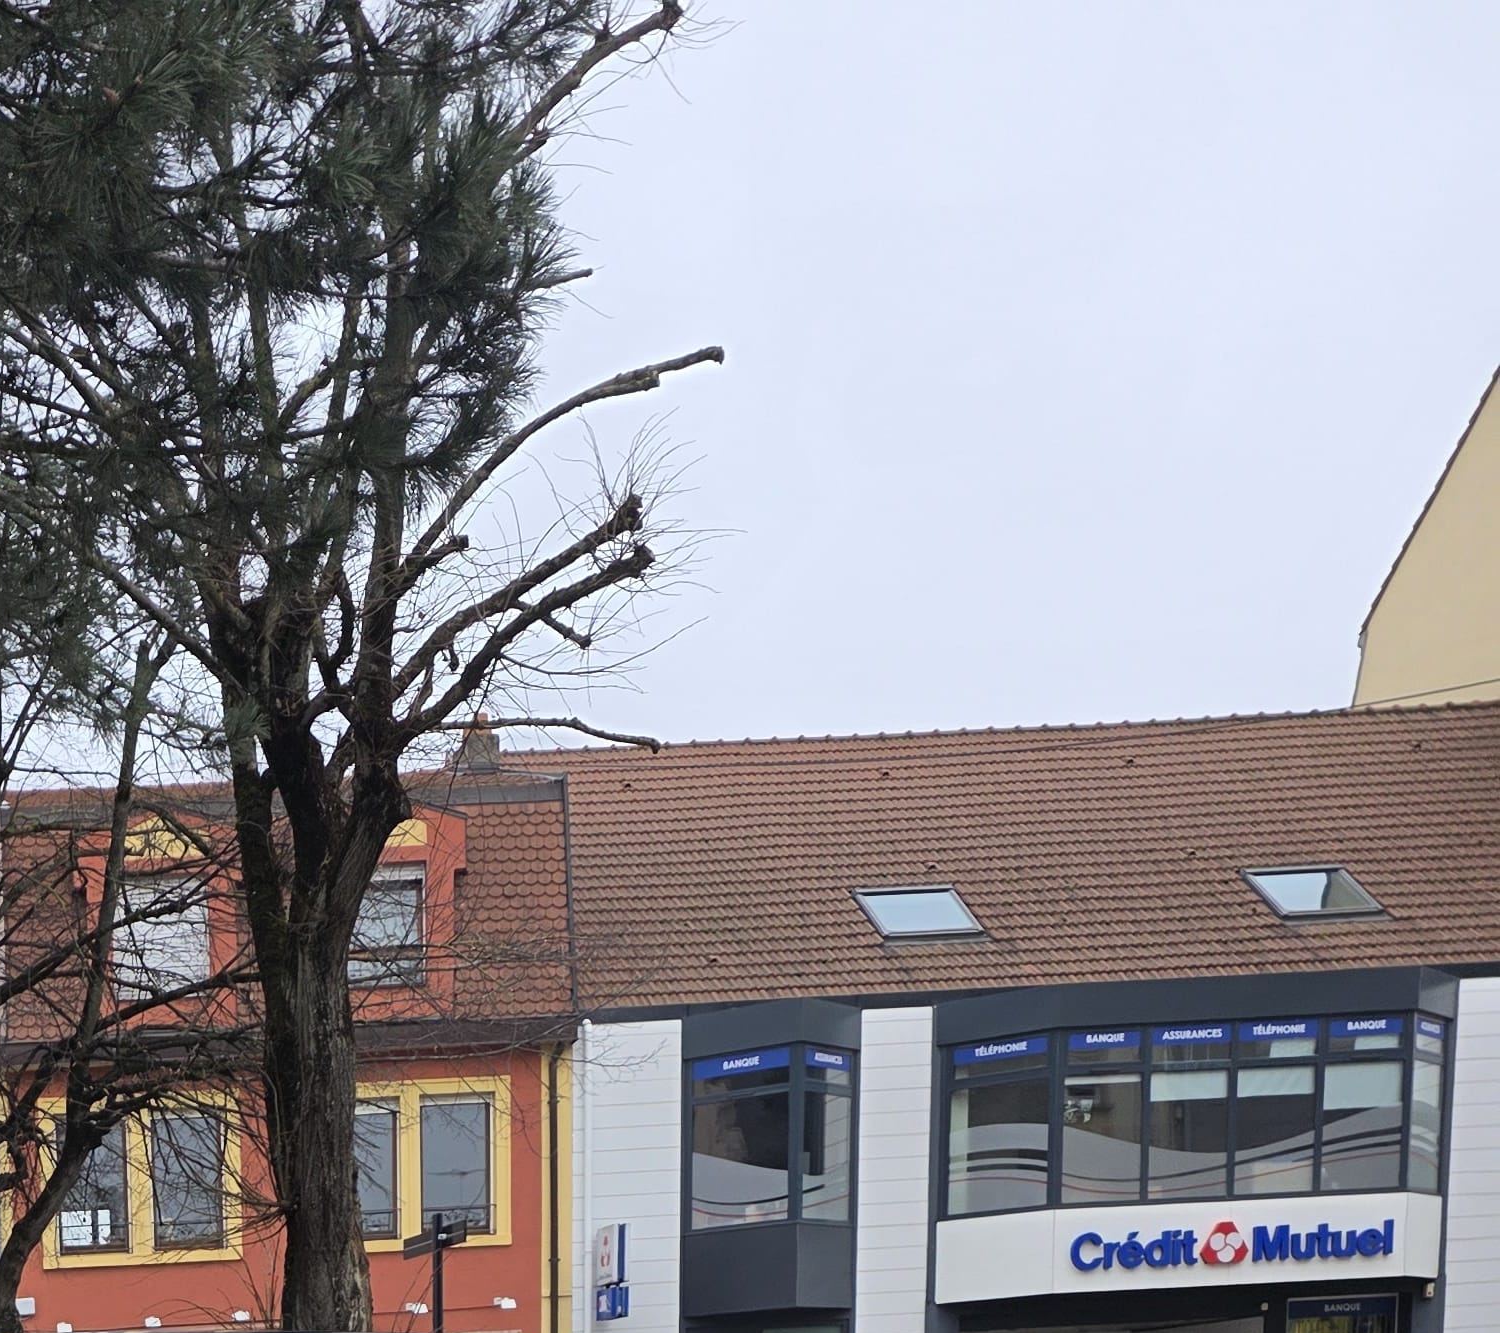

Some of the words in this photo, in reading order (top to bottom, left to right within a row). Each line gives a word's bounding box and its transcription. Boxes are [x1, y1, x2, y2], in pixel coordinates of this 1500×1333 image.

[1252, 1023, 1306, 1035] TÉLÉPHONIE
[1347, 1019, 1387, 1031] BANQUE
[1086, 1032, 1125, 1043] BANQUE
[1162, 1028, 1223, 1040] ASSURANCES
[974, 1041, 1028, 1057] TÉLÉPHONIE
[722, 1056, 760, 1070] BANQUE
[1070, 1229, 1198, 1271] Crédit
[1252, 1219, 1395, 1262] Mutuel
[1324, 1302, 1361, 1312] BANQUE
